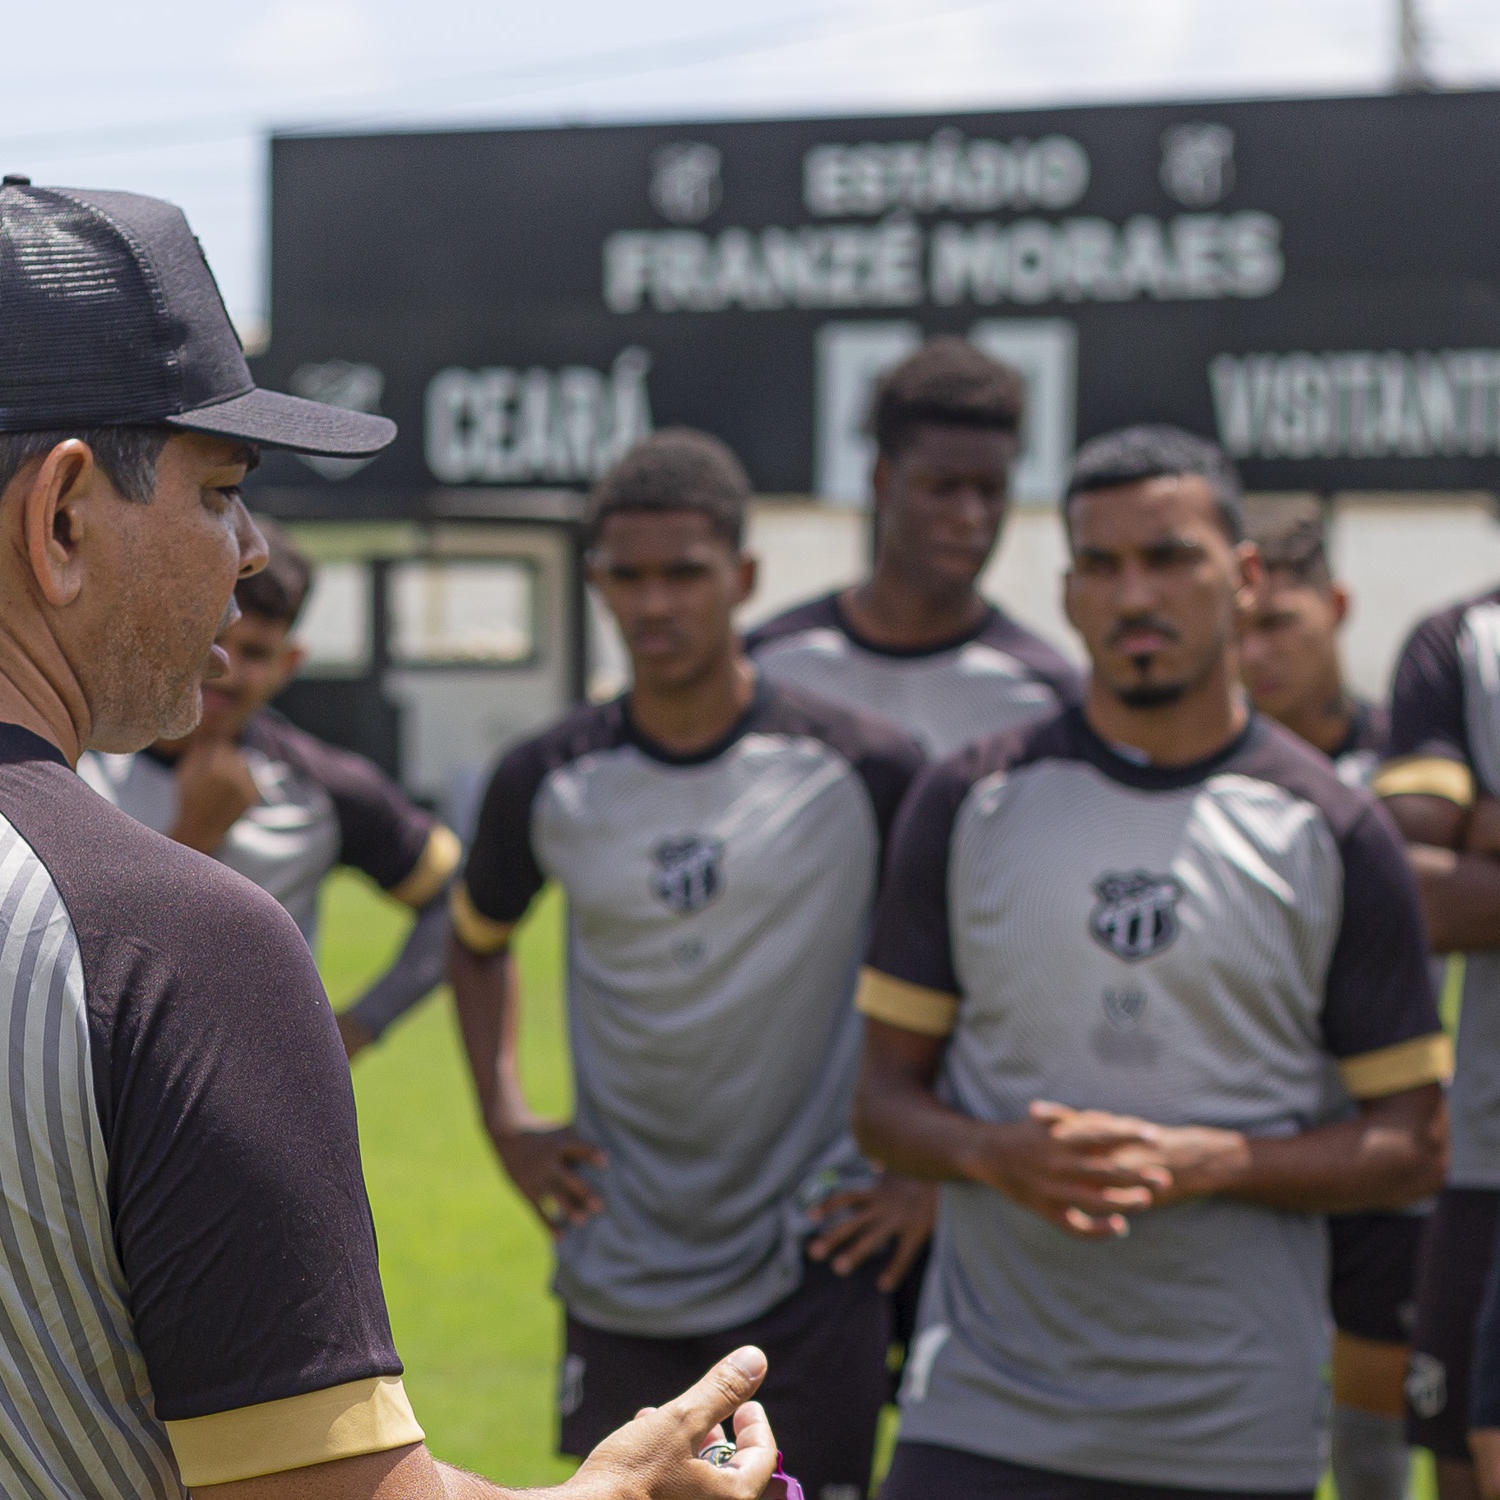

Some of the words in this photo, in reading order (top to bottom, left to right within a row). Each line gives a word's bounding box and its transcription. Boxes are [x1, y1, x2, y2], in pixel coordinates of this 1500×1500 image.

[808, 129, 1088, 212] ESTÁDIO
[608, 212, 920, 309] FRANZÉ
[932, 212, 1281, 302] MORAES
[428, 349, 648, 480] CEARÁ
